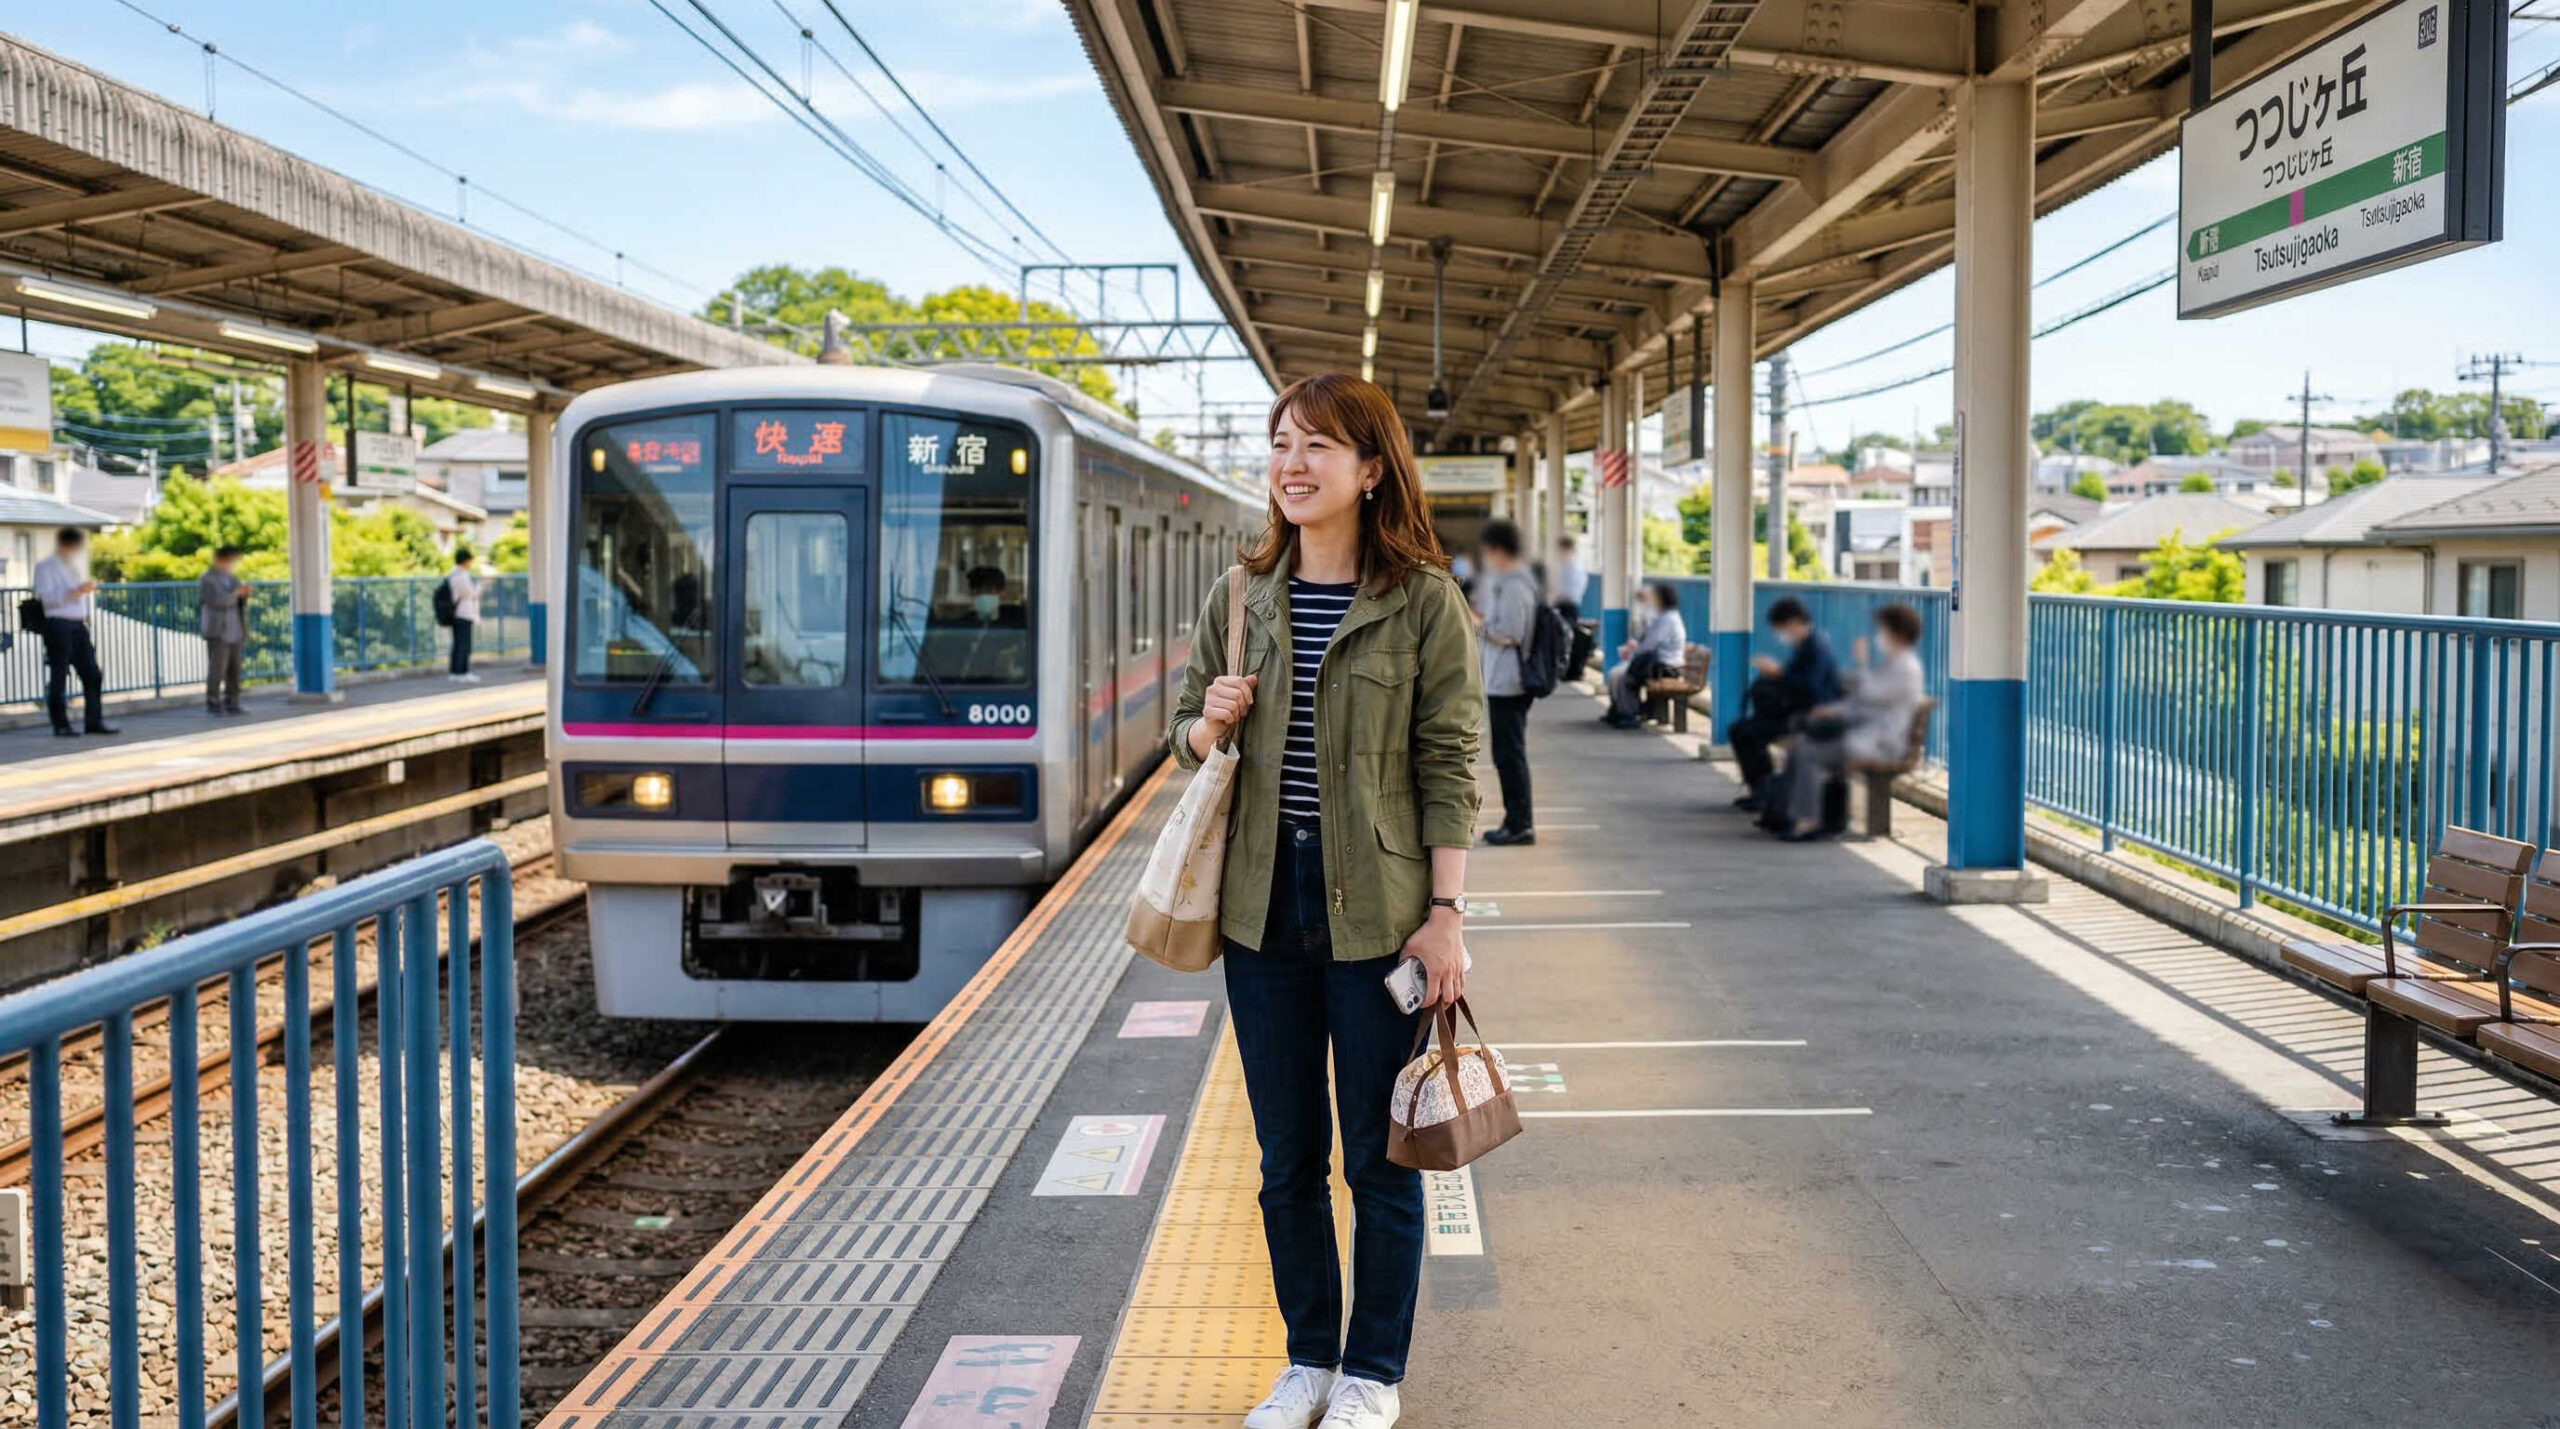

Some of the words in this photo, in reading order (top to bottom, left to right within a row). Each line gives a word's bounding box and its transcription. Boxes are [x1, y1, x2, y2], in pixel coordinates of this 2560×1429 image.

[2392, 146, 2422, 184] 新宿
[2254, 225, 2338, 272] Tsutsujigaoka
[754, 420, 847, 454] 快速
[908, 433, 987, 465] 新宿
[968, 704, 1031, 724] 8000
